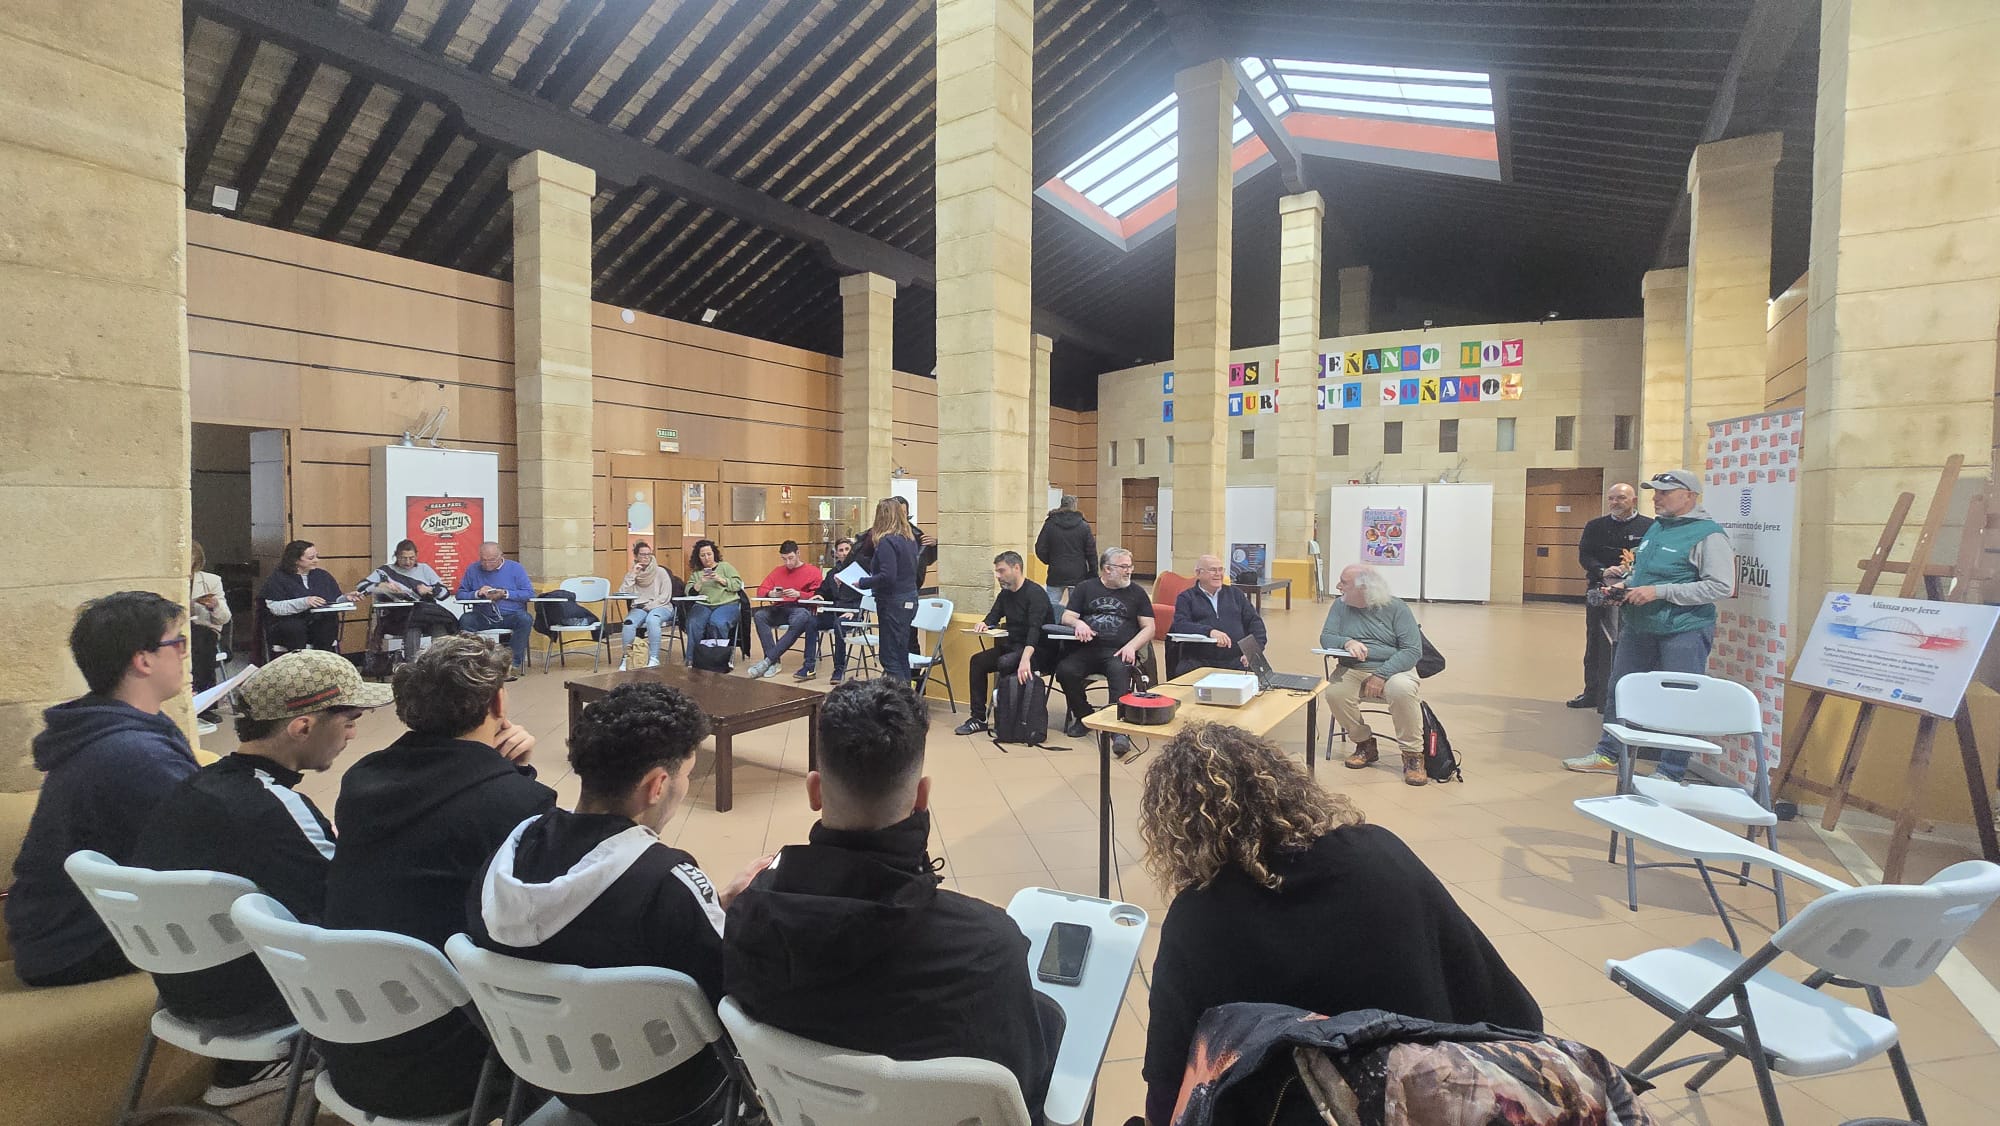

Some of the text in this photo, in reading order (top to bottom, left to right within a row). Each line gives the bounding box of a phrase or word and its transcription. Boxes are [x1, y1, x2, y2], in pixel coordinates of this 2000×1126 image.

[1461, 343, 1522, 365] HOY
[429, 516, 464, 528] Sherry
[1763, 521, 1781, 533] Jerez
[1742, 555, 1760, 568] SALA
[1741, 564, 1772, 588] PAÚL
[1870, 600, 1900, 611] Alianza
[677, 862, 714, 903] NIKE
